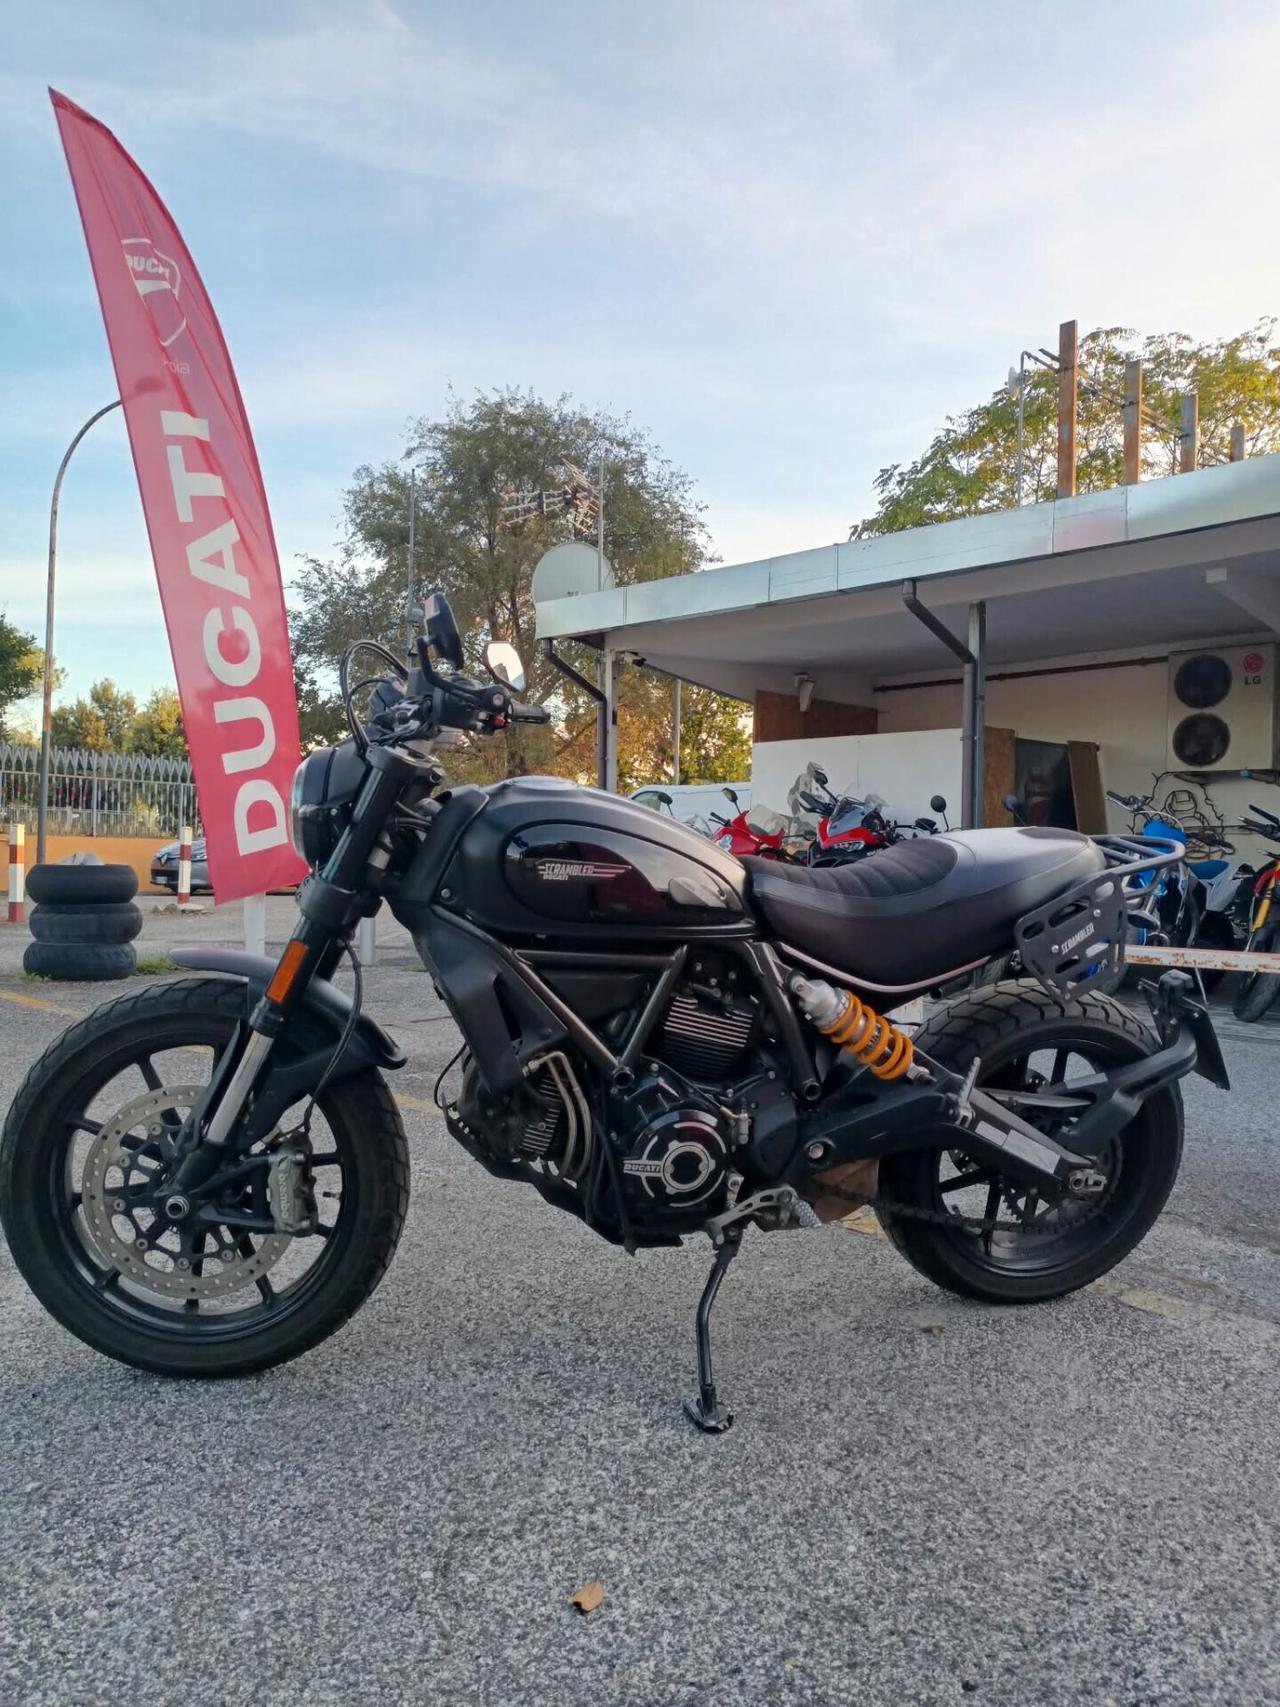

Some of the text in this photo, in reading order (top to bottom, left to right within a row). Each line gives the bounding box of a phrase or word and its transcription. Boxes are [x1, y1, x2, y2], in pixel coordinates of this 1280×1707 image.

[160, 410, 289, 857] DUCATI
[1244, 675, 1262, 686] LG
[545, 863, 595, 876] SCRAMBLER
[1060, 922, 1095, 955] SCRAMBLER
[623, 1163, 661, 1172] DUCATI
[278, 1173, 289, 1218] brembo
